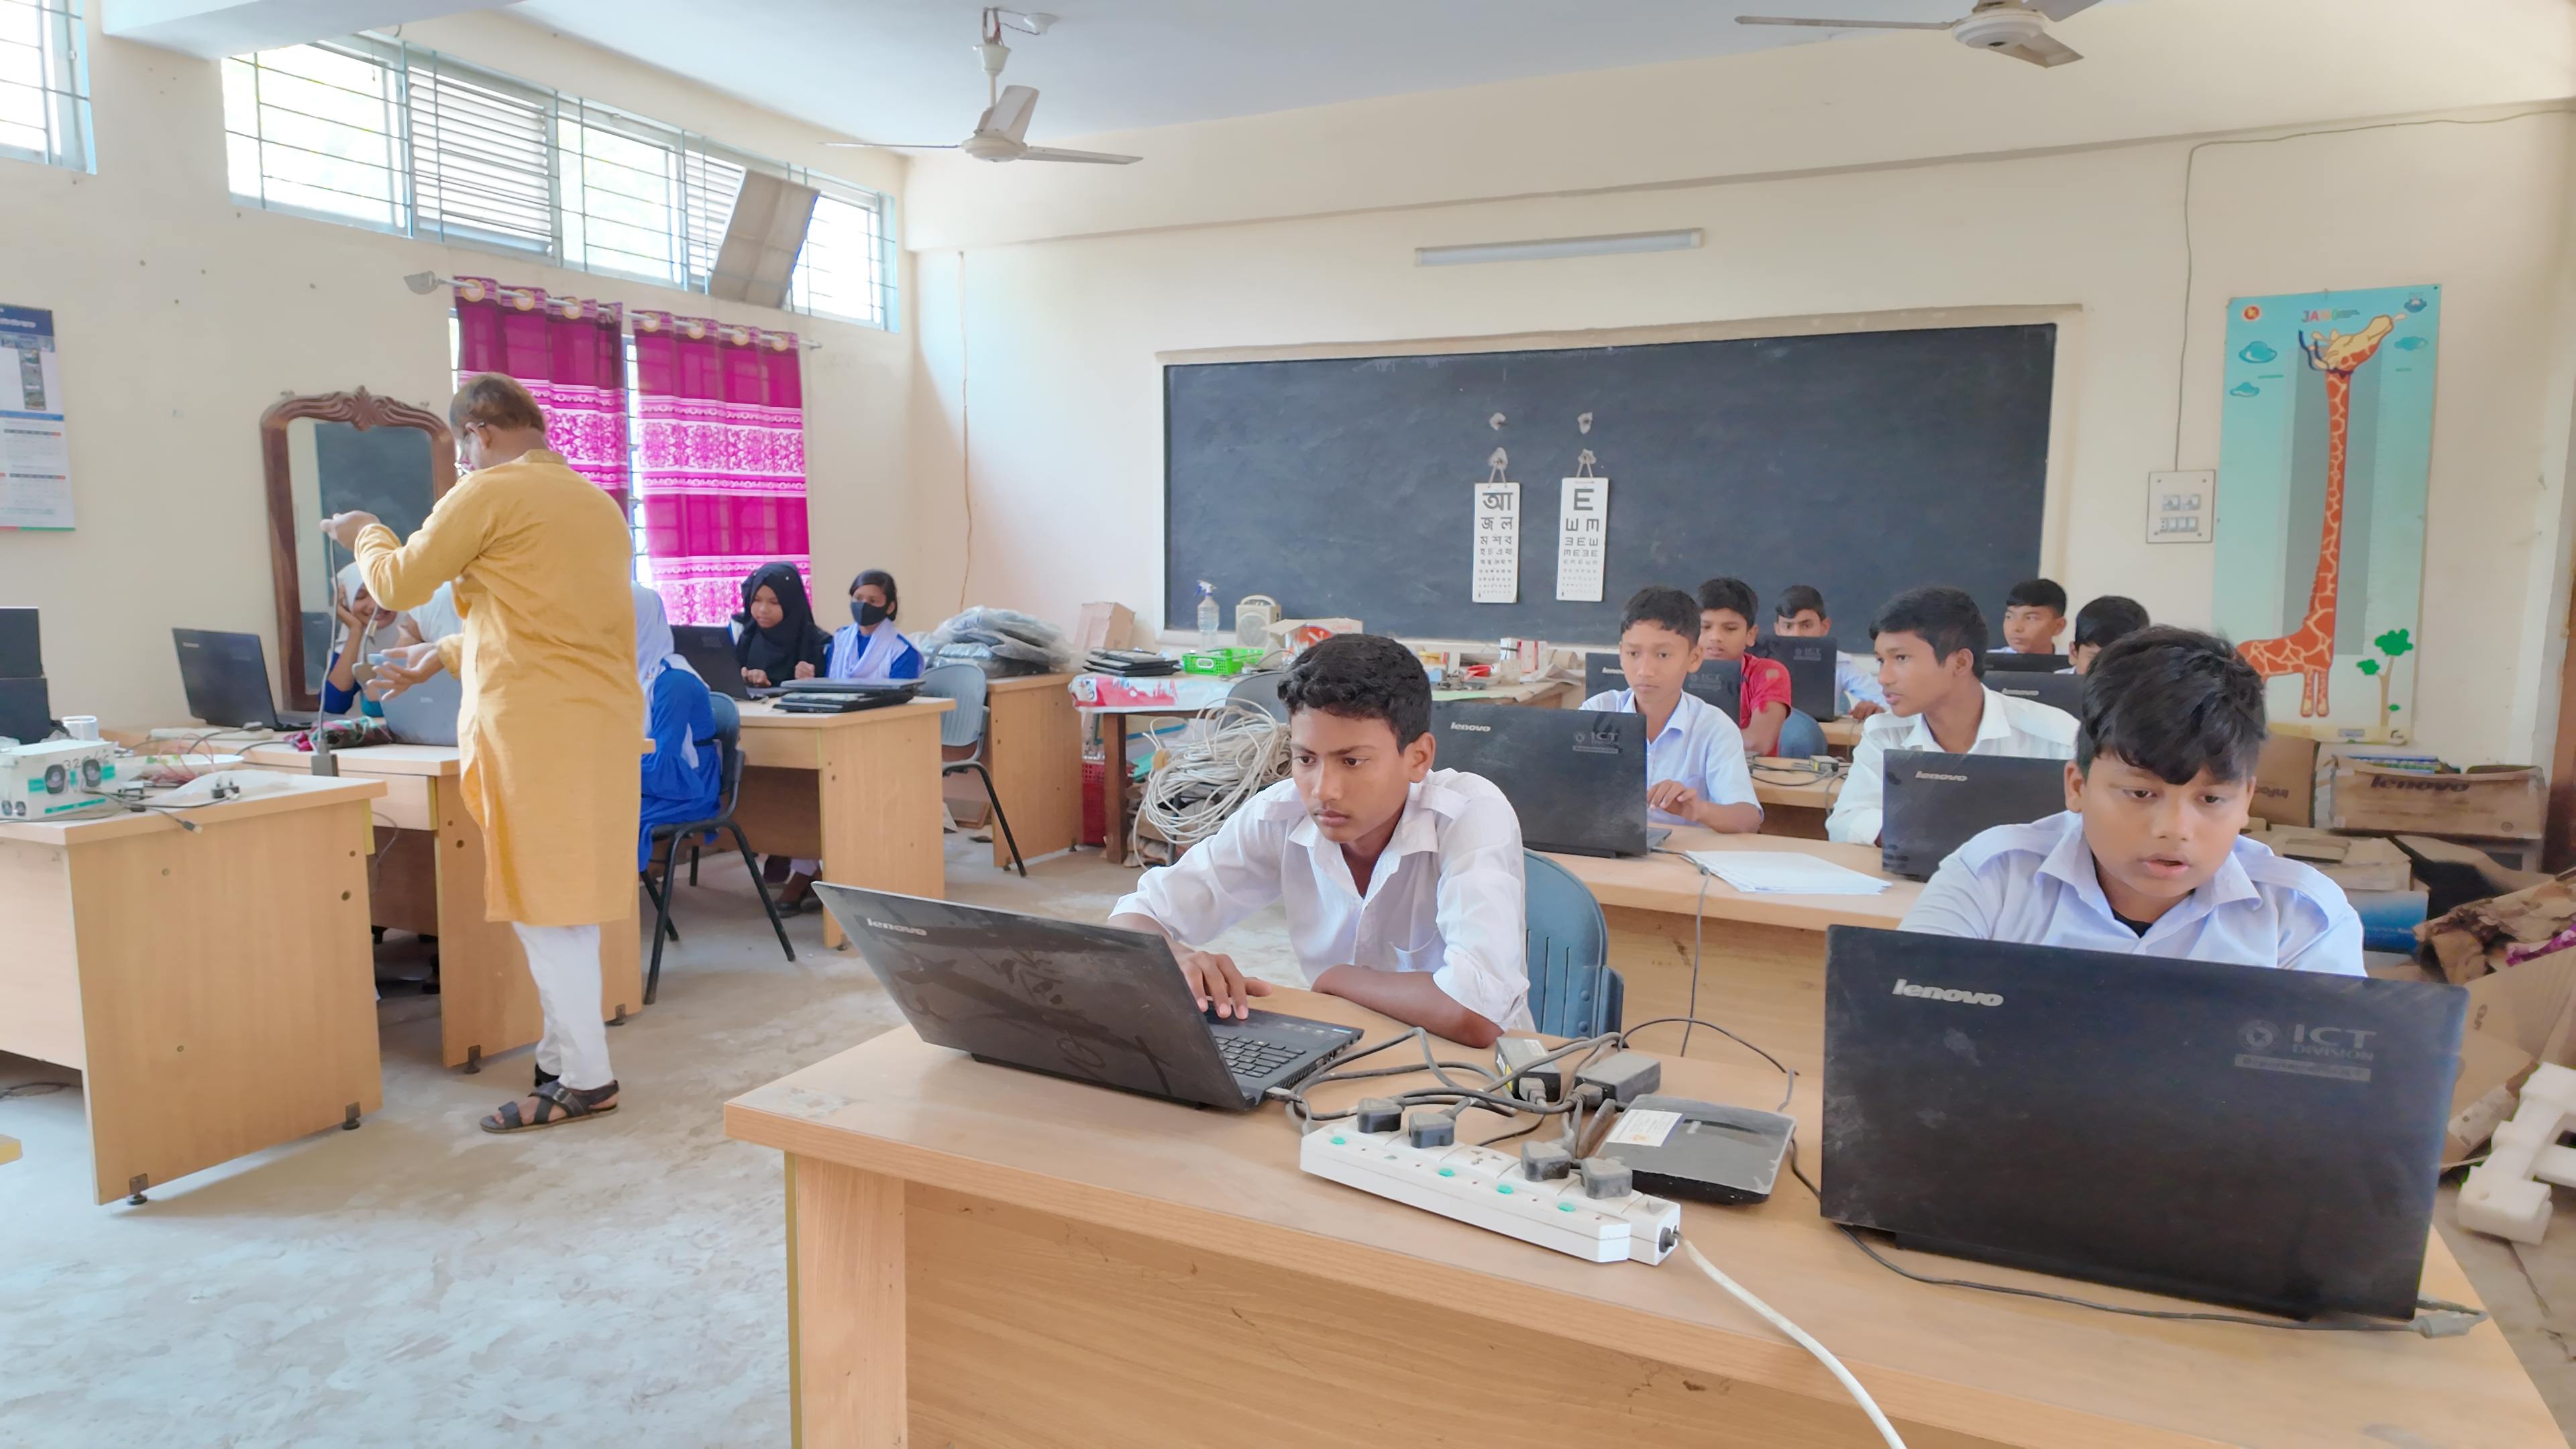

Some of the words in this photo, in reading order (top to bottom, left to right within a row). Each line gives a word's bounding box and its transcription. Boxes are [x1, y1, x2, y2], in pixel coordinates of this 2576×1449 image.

[1483, 492, 1513, 511] আ
[1574, 488, 1594, 511] E
[1481, 517, 1494, 531] জ
[1500, 517, 1513, 530] ল
[1450, 722, 1491, 732] lenovo
[1591, 732, 1619, 741] ICT
[1915, 771, 1968, 782] lenovo
[2371, 774, 2470, 792] lenovo
[866, 918, 928, 936] lenovo
[1892, 978, 2004, 1007] lenovo
[2294, 1024, 2377, 1049] ICT
